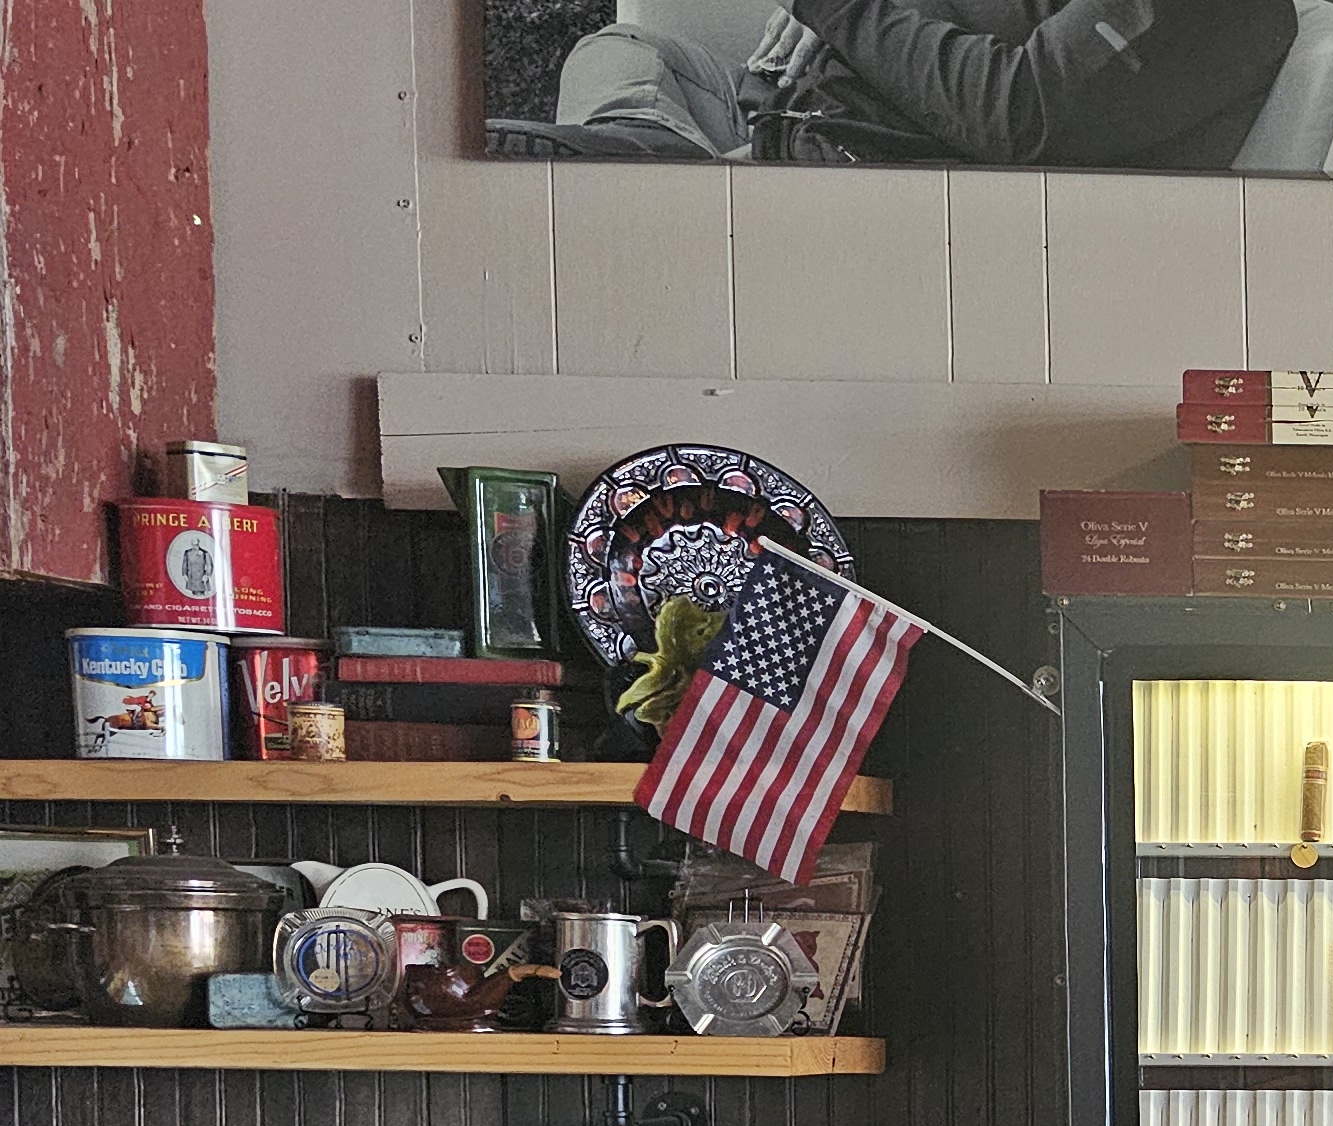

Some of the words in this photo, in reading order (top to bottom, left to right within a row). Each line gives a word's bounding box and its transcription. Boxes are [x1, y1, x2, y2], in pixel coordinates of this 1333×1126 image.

[198, 514, 259, 532] ABERT
[1081, 522, 1109, 531] Oliva
[1139, 522, 1149, 532] V
[82, 658, 149, 679] Kentucky
[152, 658, 187, 677] Cb
